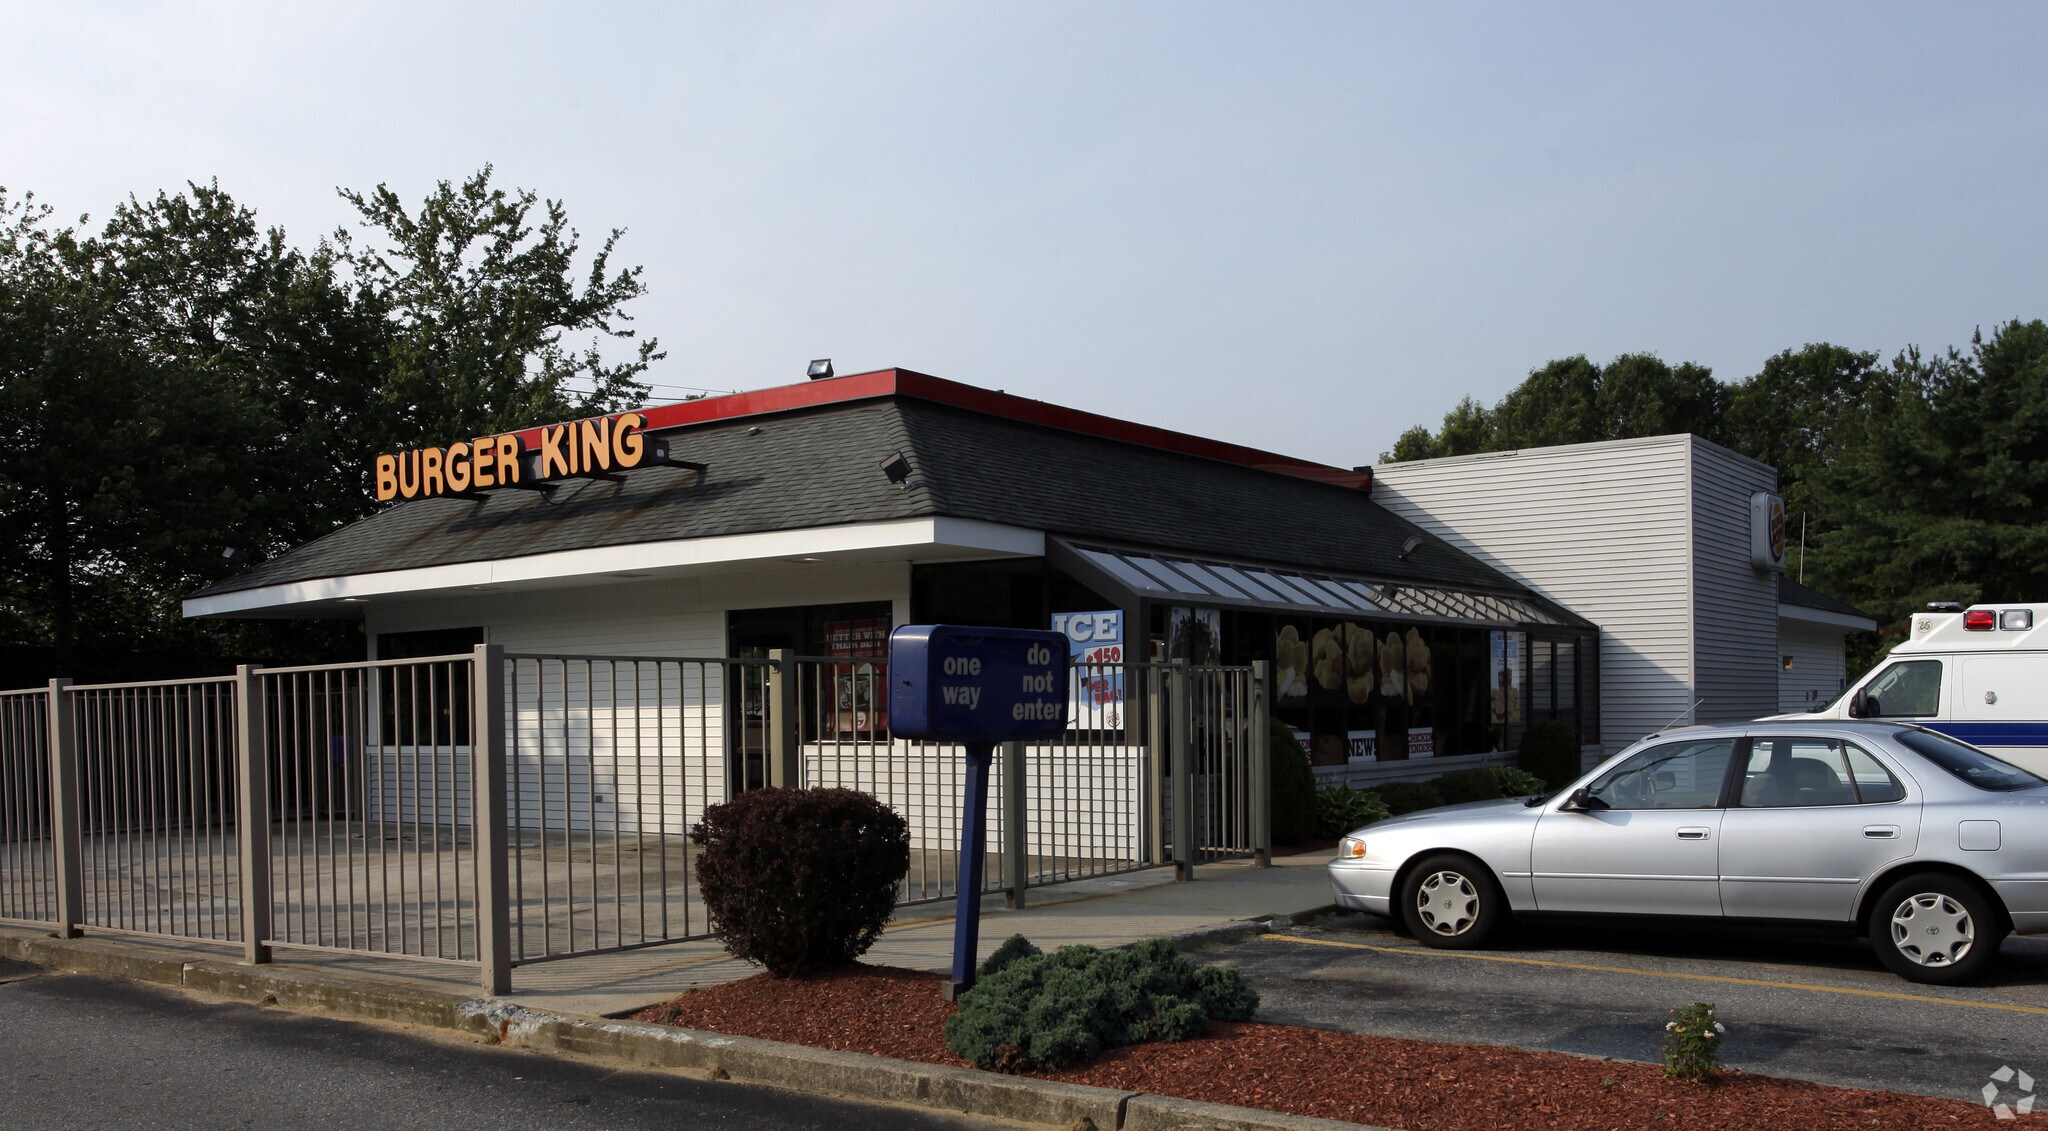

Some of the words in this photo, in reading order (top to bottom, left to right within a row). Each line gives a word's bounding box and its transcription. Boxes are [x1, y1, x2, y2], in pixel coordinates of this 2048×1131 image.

[376, 434, 520, 501] BURGER
[541, 413, 645, 478] KING
[1054, 613, 1118, 642] ICE
[1027, 643, 1050, 665] do
[943, 656, 981, 676] one
[1022, 671, 1053, 693] not
[942, 686, 981, 710] way
[1012, 698, 1062, 720] enter
